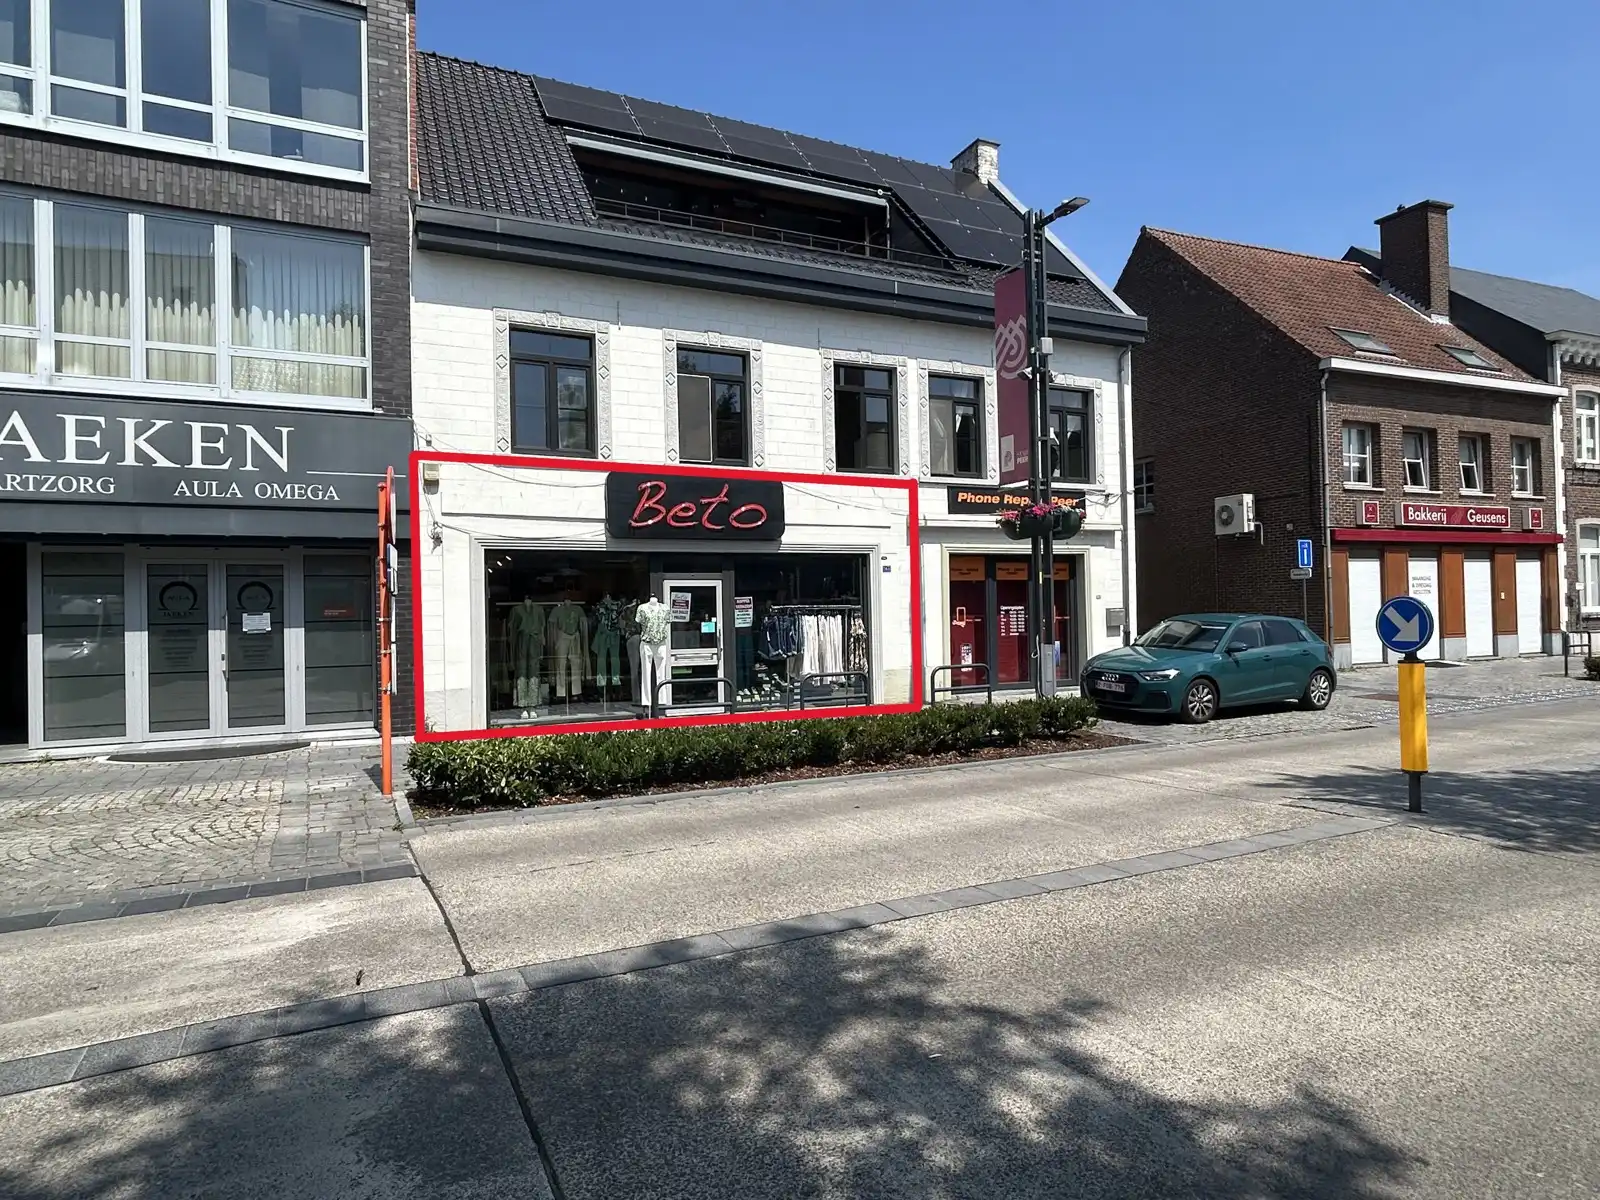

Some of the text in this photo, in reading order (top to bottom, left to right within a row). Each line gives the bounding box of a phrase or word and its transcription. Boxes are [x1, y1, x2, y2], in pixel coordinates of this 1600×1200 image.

[0, 473, 116, 494] RTZORG
[173, 479, 341, 501] AULA OMEGA
[628, 480, 768, 530] Beto
[957, 492, 1000, 504] Phone
[1003, 494, 1031, 506] Rep
[1408, 506, 1506, 525] Bakkerij Geusens
